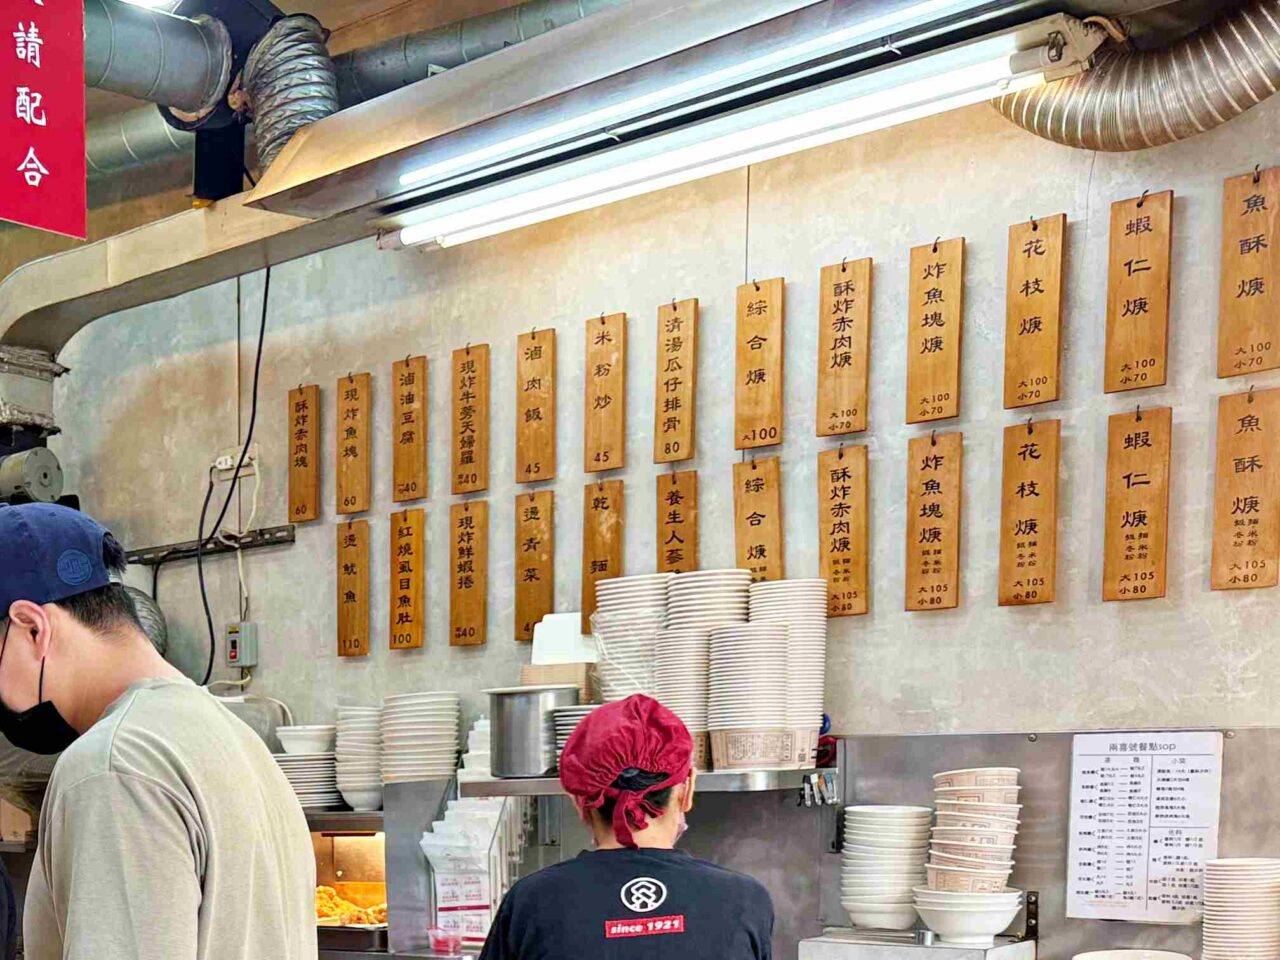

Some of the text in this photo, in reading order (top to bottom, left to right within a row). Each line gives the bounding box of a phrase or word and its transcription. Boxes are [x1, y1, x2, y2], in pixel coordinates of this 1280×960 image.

[593, 331, 612, 409] 米粉炒
[664, 441, 680, 454] 80
[594, 451, 609, 463] 45
[525, 462, 540, 474] 45
[344, 496, 357, 506] 60
[295, 505, 307, 515] 60
[523, 622, 533, 634] 4
[342, 638, 360, 649] 110
[393, 634, 411, 645] 100
[610, 919, 680, 934] since 1921
